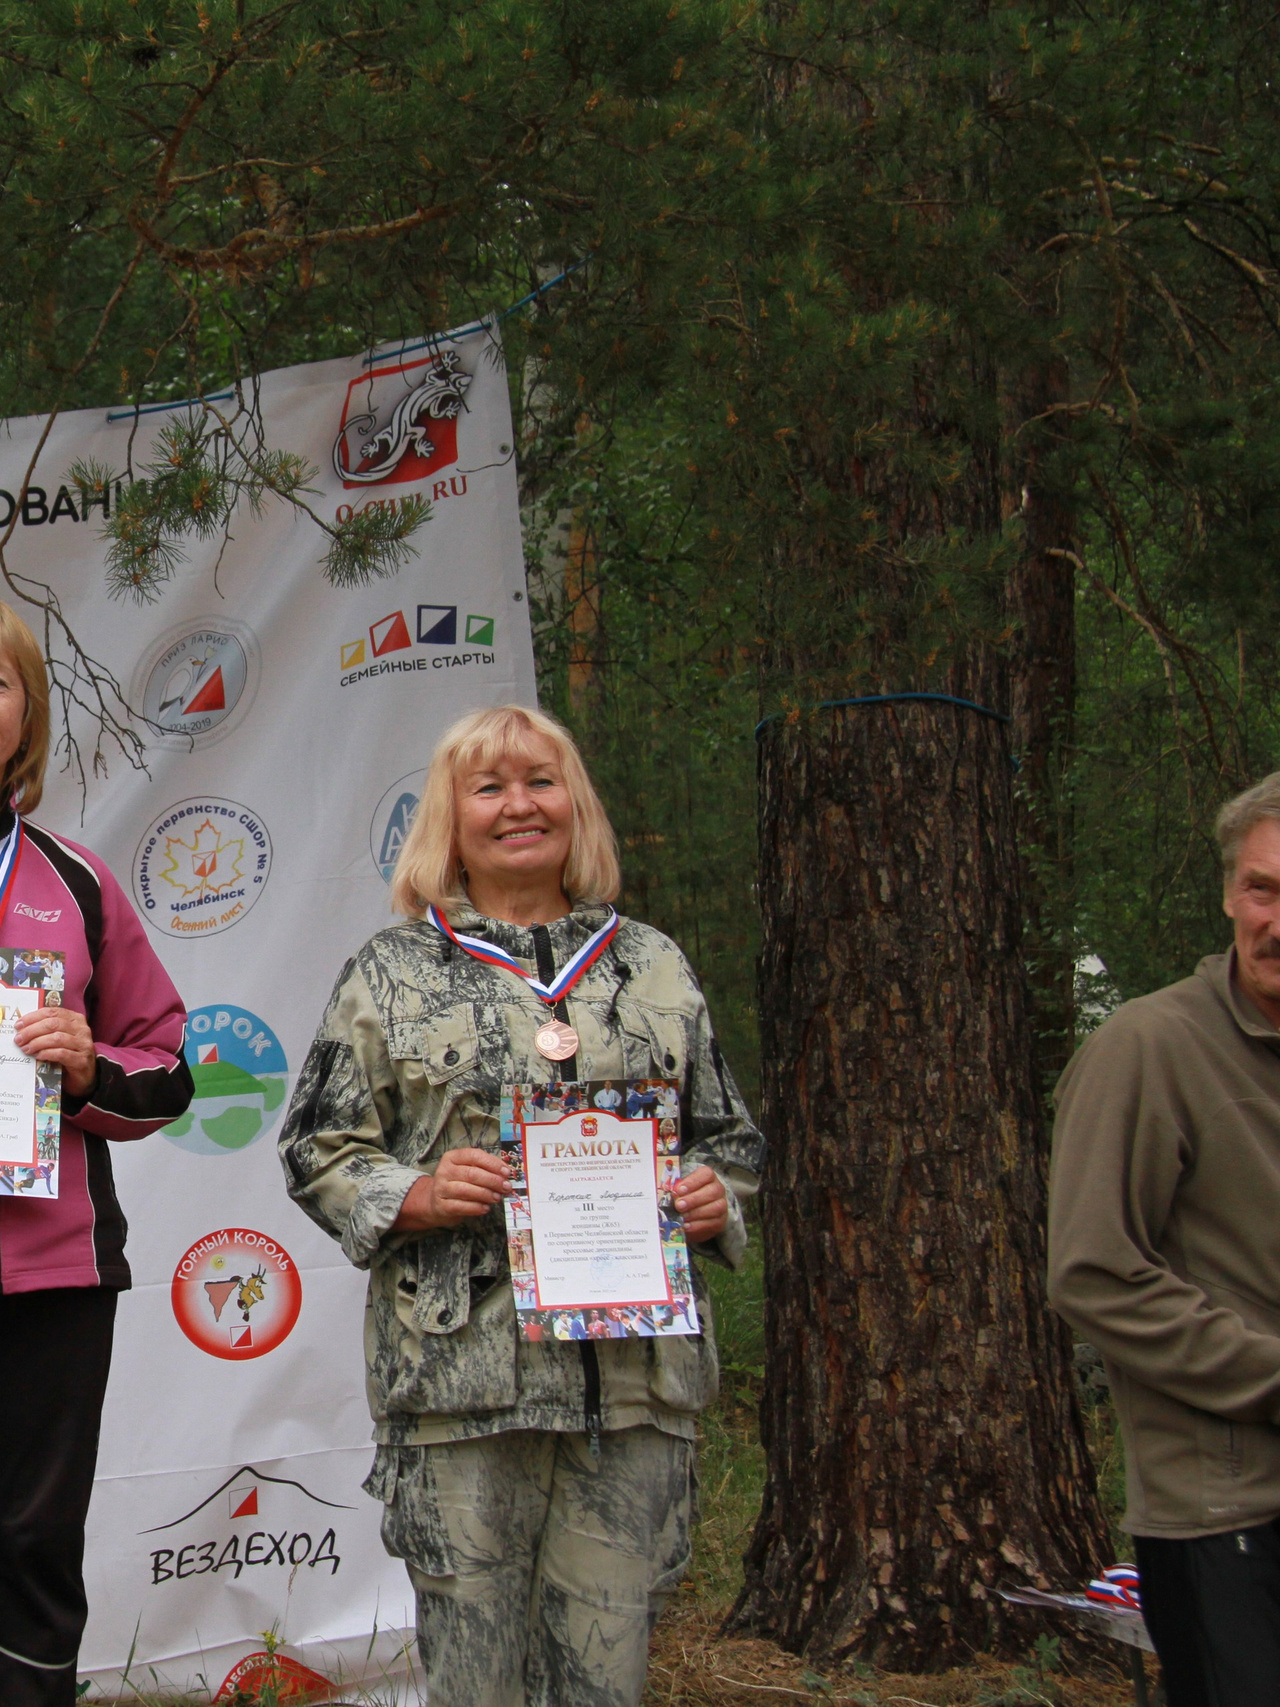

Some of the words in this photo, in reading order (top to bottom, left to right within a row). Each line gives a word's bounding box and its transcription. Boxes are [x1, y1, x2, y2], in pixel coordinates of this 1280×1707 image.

[340, 659, 427, 687] СЕМЕЙНЫЕ
[432, 653, 495, 669] СТАРТЫ
[139, 836, 157, 910] Открытое
[156, 805, 237, 835] первенство
[238, 814, 266, 848] СШОР
[253, 875, 263, 884] 5
[170, 888, 246, 912] Челябинск
[170, 915, 217, 932] Осенний
[220, 902, 244, 923] лист
[185, 1011, 272, 1058] ОРОК
[540, 1140, 640, 1159] ГРАМОТА
[582, 1203, 595, 1212] III
[177, 1229, 229, 1280] ГОРНЫЙ
[233, 1231, 290, 1271] КОРОЛЬ
[149, 1528, 341, 1586] ВЕЗДЕХОД
